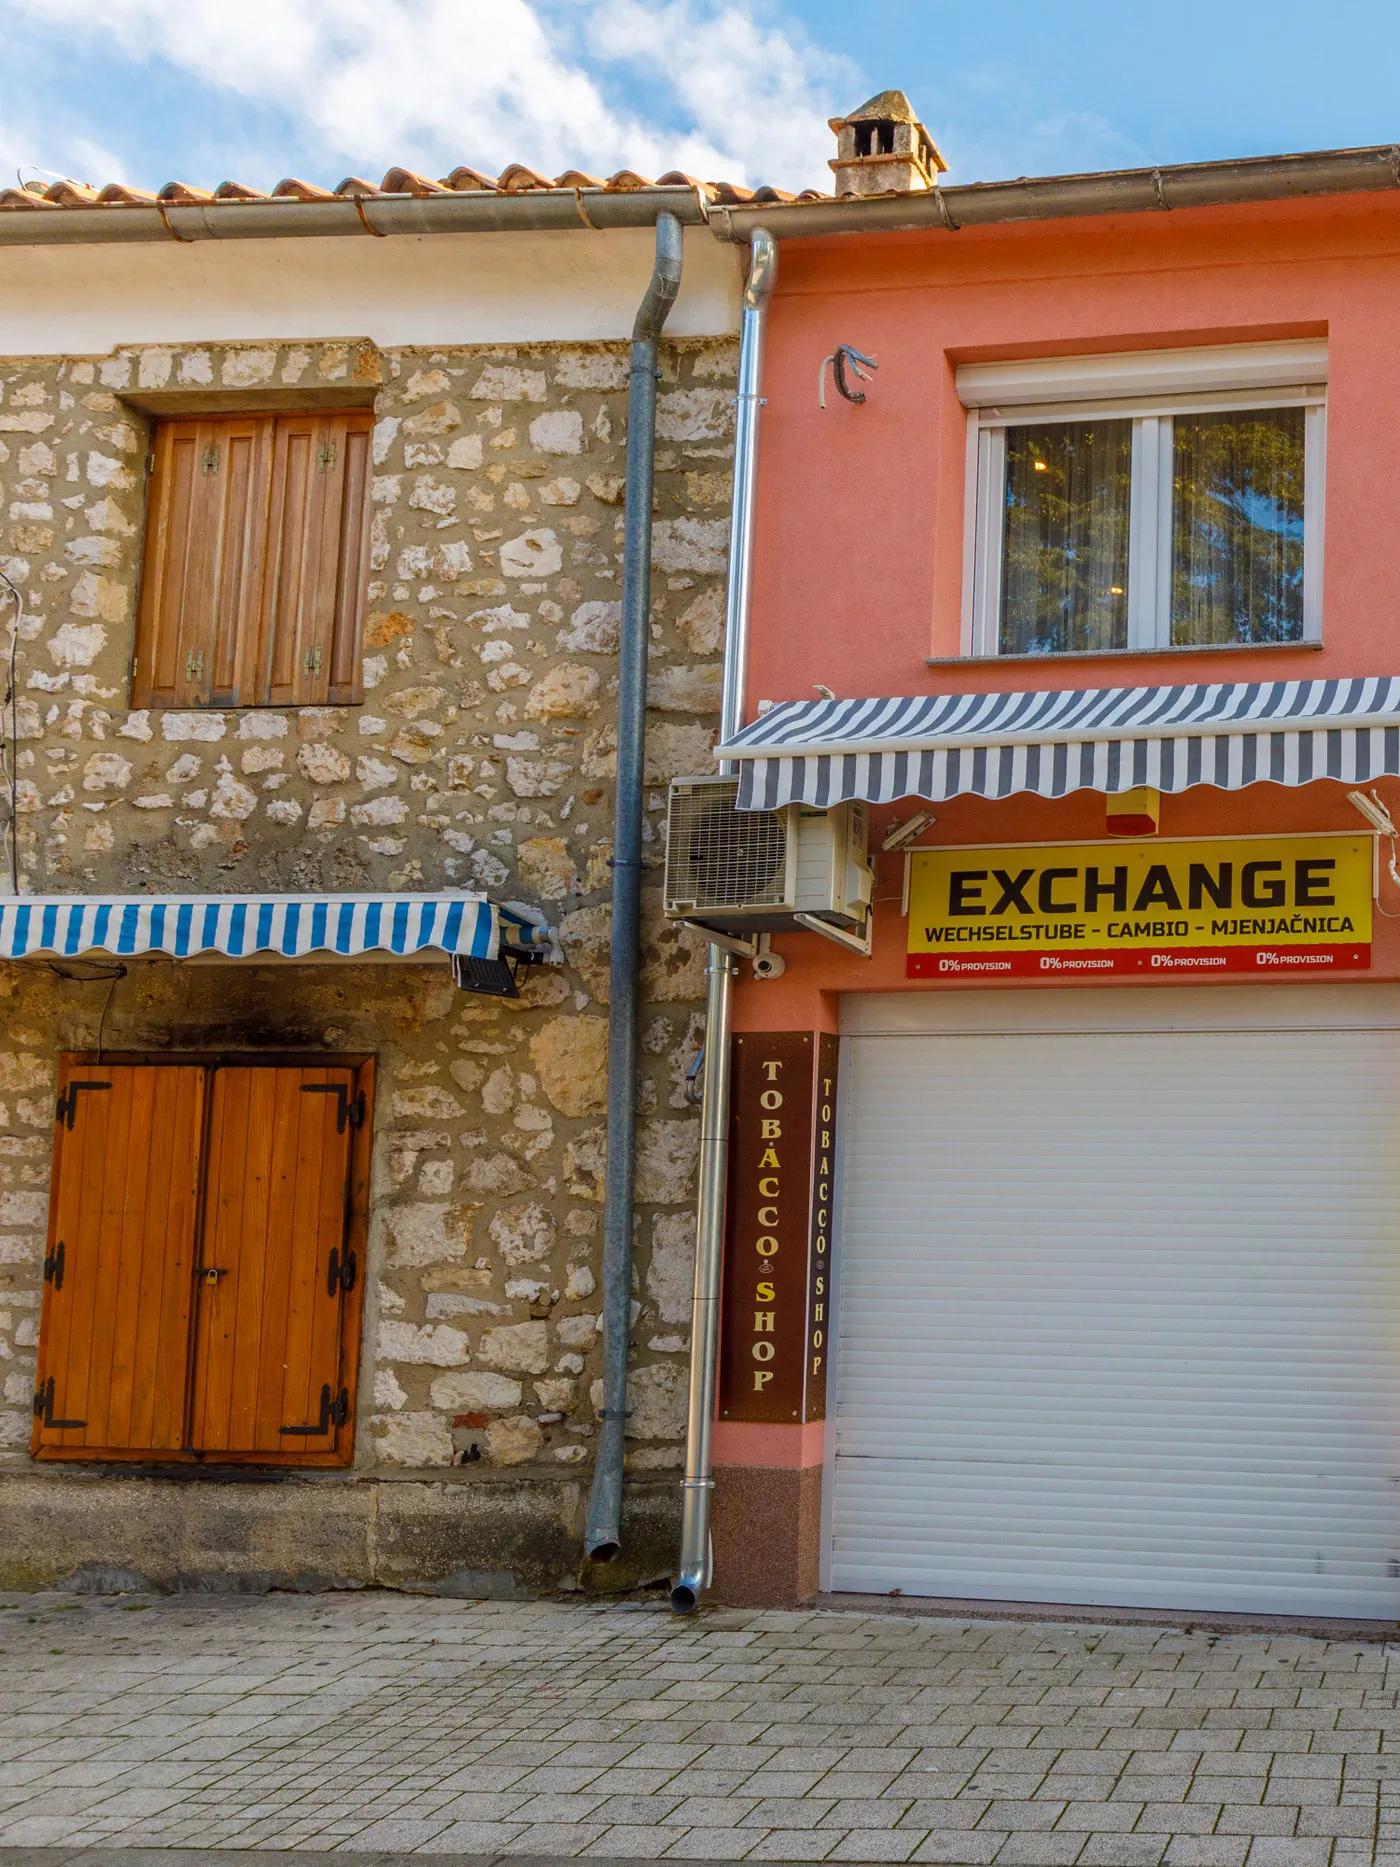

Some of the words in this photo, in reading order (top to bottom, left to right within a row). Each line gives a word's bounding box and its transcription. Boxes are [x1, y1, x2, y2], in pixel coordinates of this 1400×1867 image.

[925, 923, 1086, 943] WECHSELSTUBE
[1107, 919, 1190, 938] CAMBIO
[1211, 913, 1355, 936] MJENJAČNICA
[948, 858, 1337, 917] EXCHANGE
[939, 959, 961, 971] 0%
[961, 961, 1011, 971] PROVISION
[1040, 957, 1062, 969] 0%
[1062, 959, 1114, 969] PROVISION
[1151, 954, 1173, 967] 0%
[1174, 957, 1226, 966] PROVISION
[1256, 952, 1279, 964] 0%
[1280, 955, 1334, 964] PROVISION
[755, 1060, 784, 1257] TOBACCO
[816, 1077, 832, 1254] TOBACCO
[752, 1281, 776, 1391] SHOP
[812, 1276, 824, 1376] SHOP
